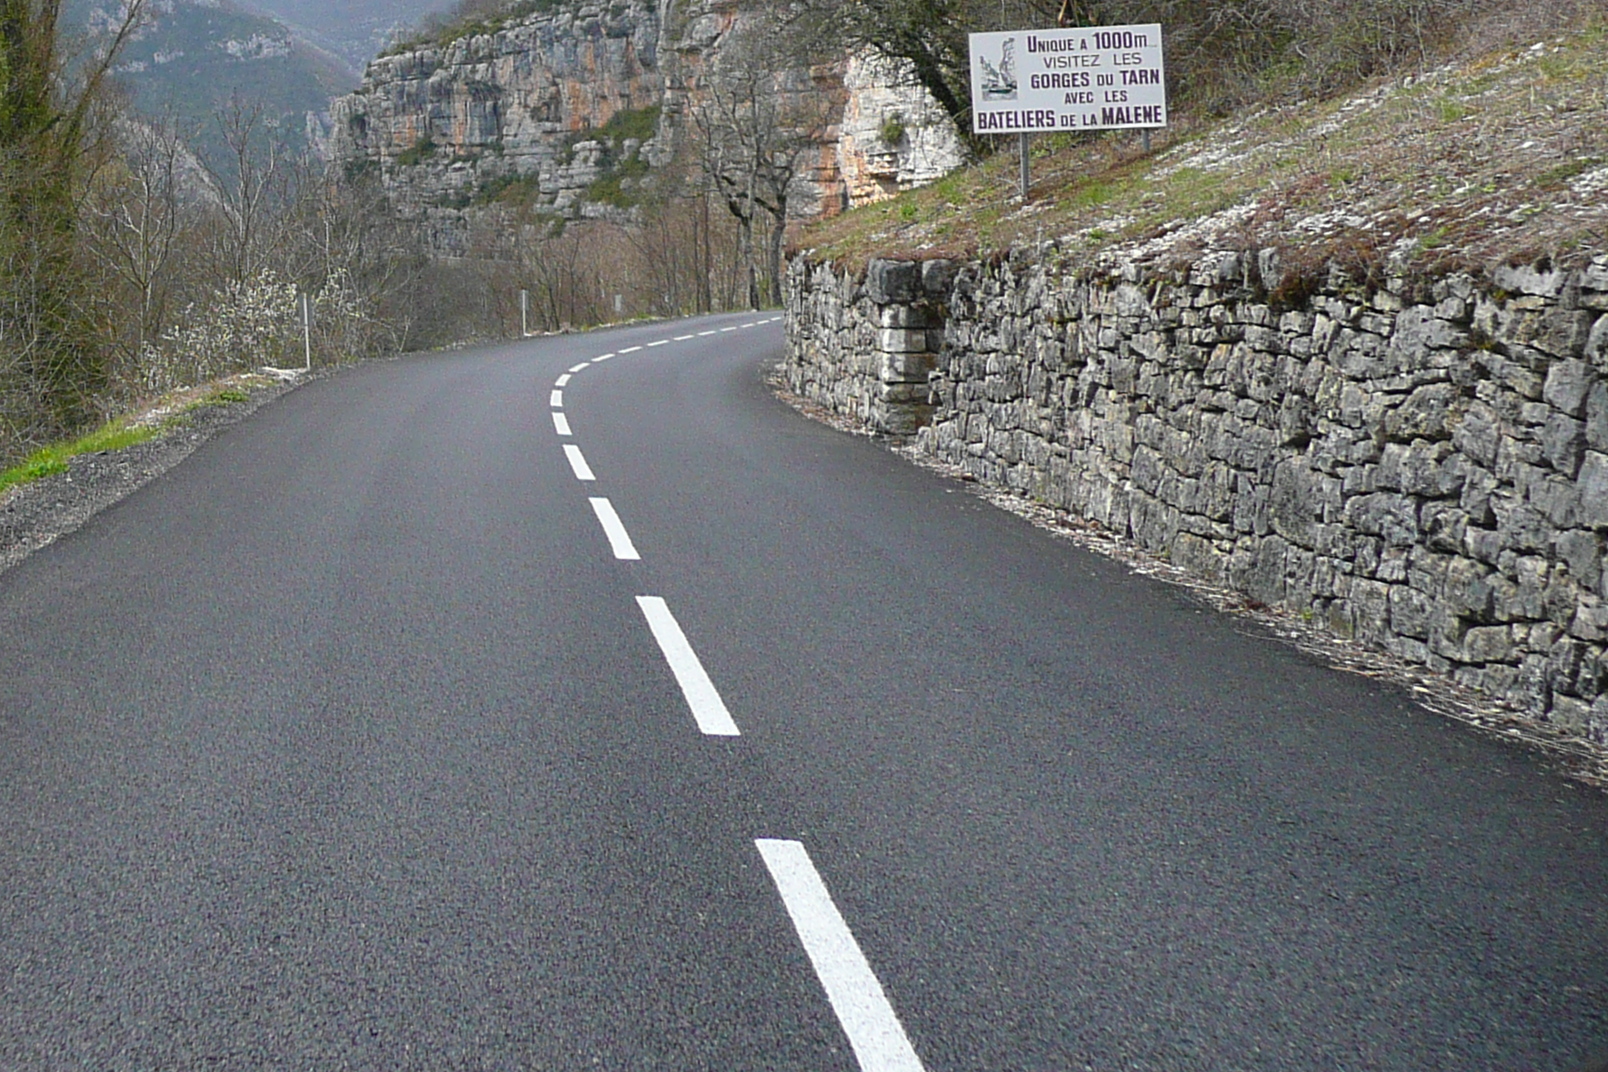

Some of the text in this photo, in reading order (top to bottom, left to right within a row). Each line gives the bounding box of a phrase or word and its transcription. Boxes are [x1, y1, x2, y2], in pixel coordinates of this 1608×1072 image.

[1080, 39, 1087, 50] A
[1044, 53, 1142, 69] VISITEZ LES
[1031, 69, 1159, 88] GORGES DU TARN
[1064, 90, 1127, 104] AVEC LES
[978, 105, 1162, 129] BATELIERS DE LA MALENE
